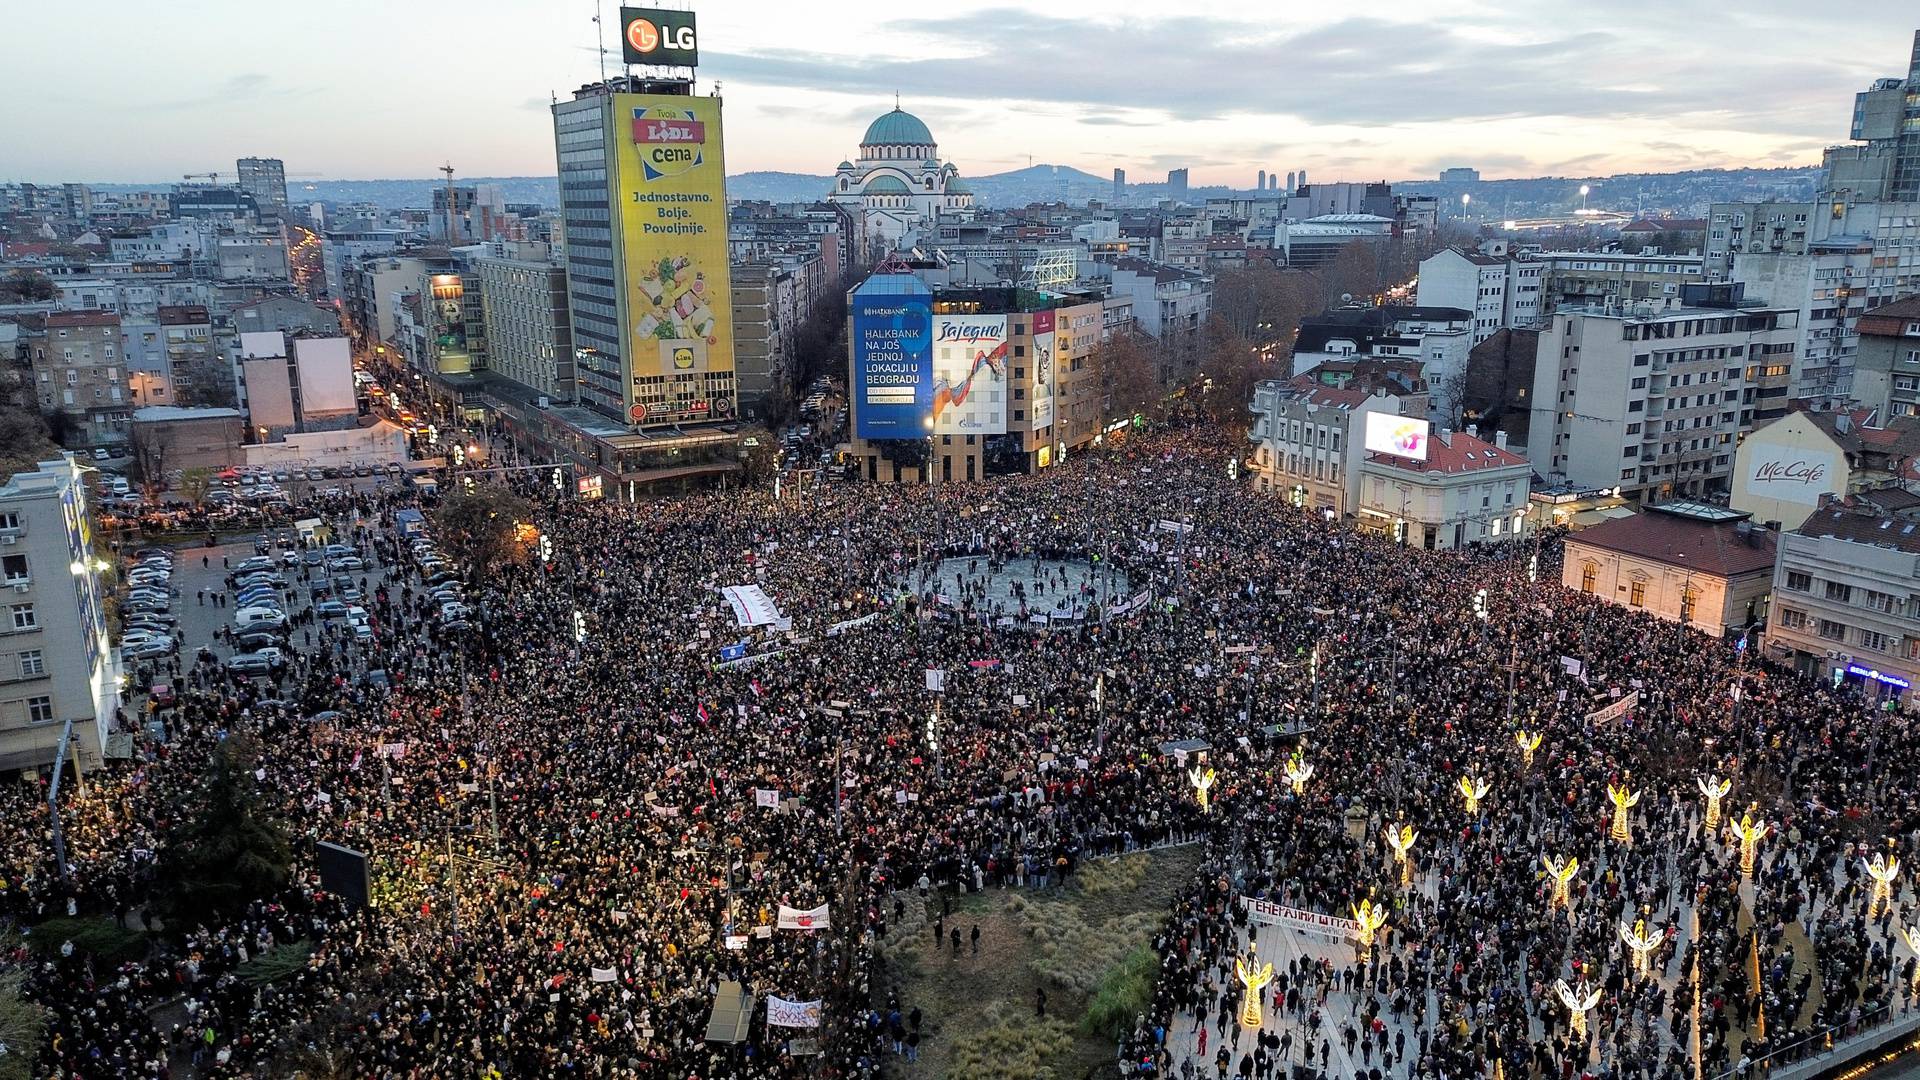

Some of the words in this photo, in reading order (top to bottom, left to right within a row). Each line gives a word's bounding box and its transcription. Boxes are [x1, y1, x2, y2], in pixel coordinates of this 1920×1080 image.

[662, 26, 695, 50] LG
[657, 109, 676, 119] Tvoja
[652, 148, 692, 163] cena
[633, 191, 713, 202] Jednostavno.
[657, 207, 692, 220] Bolje.
[643, 223, 707, 235] Povoljnije.
[865, 330, 919, 338] HALKBANK
[865, 341, 880, 349] NA
[882, 339, 900, 349] JOŠ
[866, 352, 903, 361] JEDNOJ
[866, 364, 909, 373] LOKACIJI
[911, 364, 918, 373] U
[866, 375, 920, 384] BEOGRADU
[1756, 461, 1825, 485] McCafé
